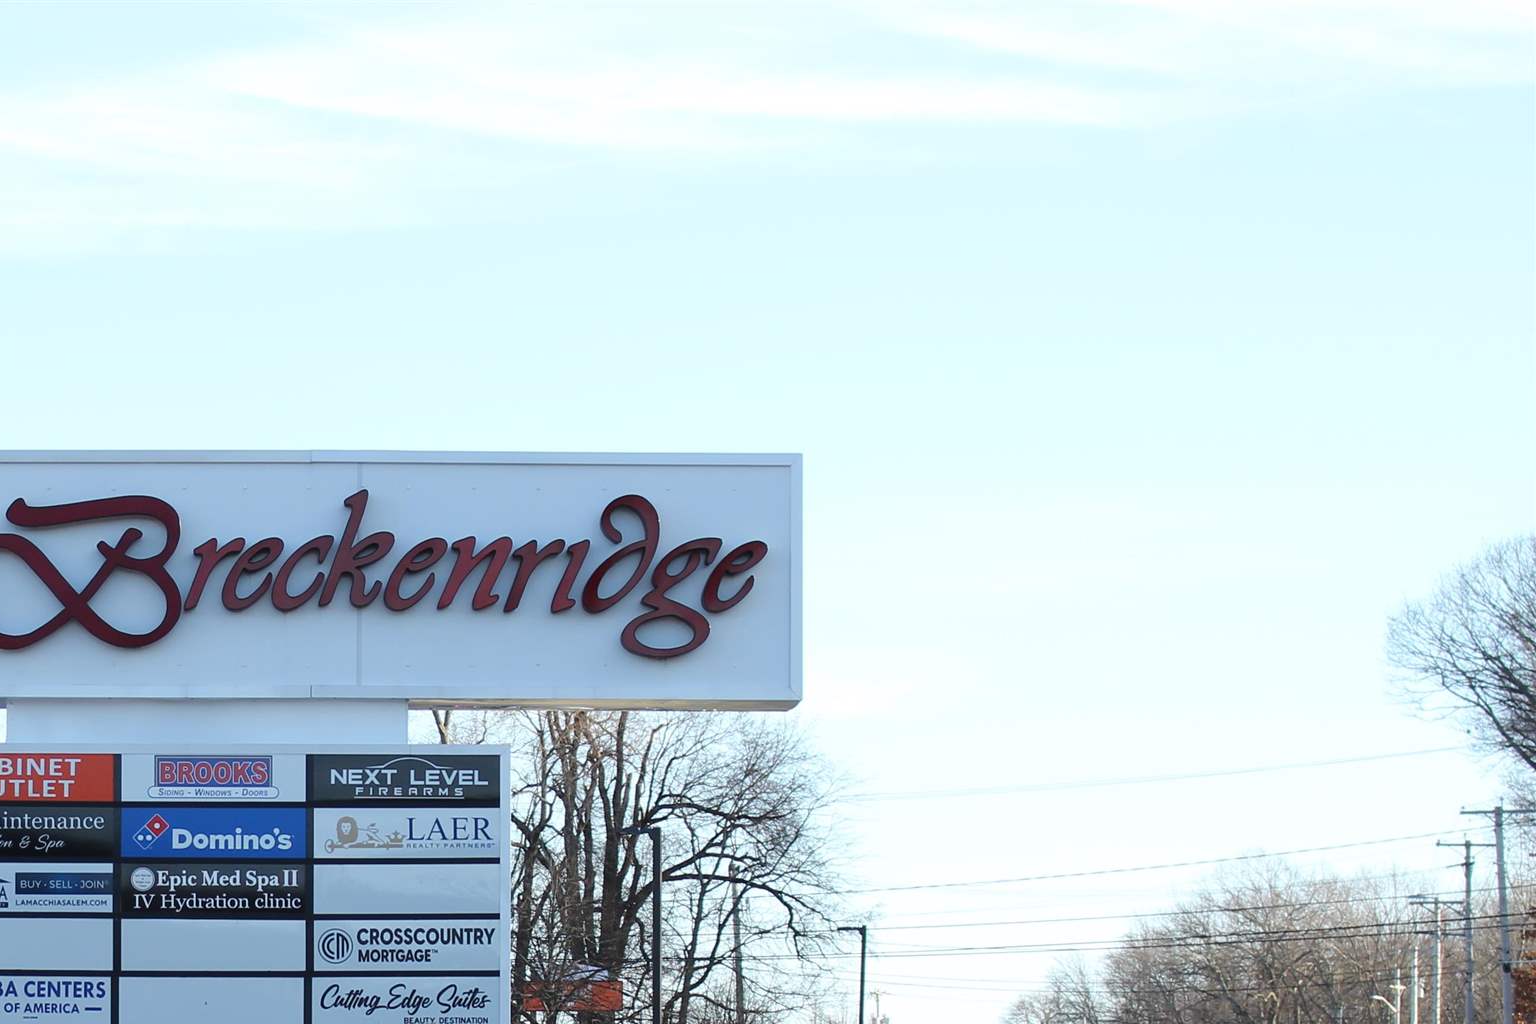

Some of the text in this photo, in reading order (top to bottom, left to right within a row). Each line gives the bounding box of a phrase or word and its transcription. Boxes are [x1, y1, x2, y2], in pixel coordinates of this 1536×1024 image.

[159, 761, 268, 785] BROOKS
[330, 769, 489, 785] NEXT LEVEL
[355, 787, 464, 796] FIREARMS
[406, 817, 493, 841] LAER
[19, 835, 31, 847] &
[35, 834, 64, 853] Spa
[172, 827, 292, 850] Domino's
[20, 880, 41, 889] BUY
[49, 880, 72, 889] SELL
[156, 869, 197, 891] Epic
[201, 870, 241, 887] Med
[245, 870, 280, 891] Spa
[282, 869, 299, 887] II
[15, 899, 107, 907] LAMACCHIASALEM.COM
[133, 893, 302, 912] IV Hydration clinic
[356, 928, 496, 945] CROSSCOUNTRY
[24, 981, 106, 999] CENTERS
[4, 1002, 80, 1014] OF AMERICA
[320, 983, 492, 1016] Cutting Edge Suites
[404, 1017, 489, 1024] BEAUTY DESTINATION
